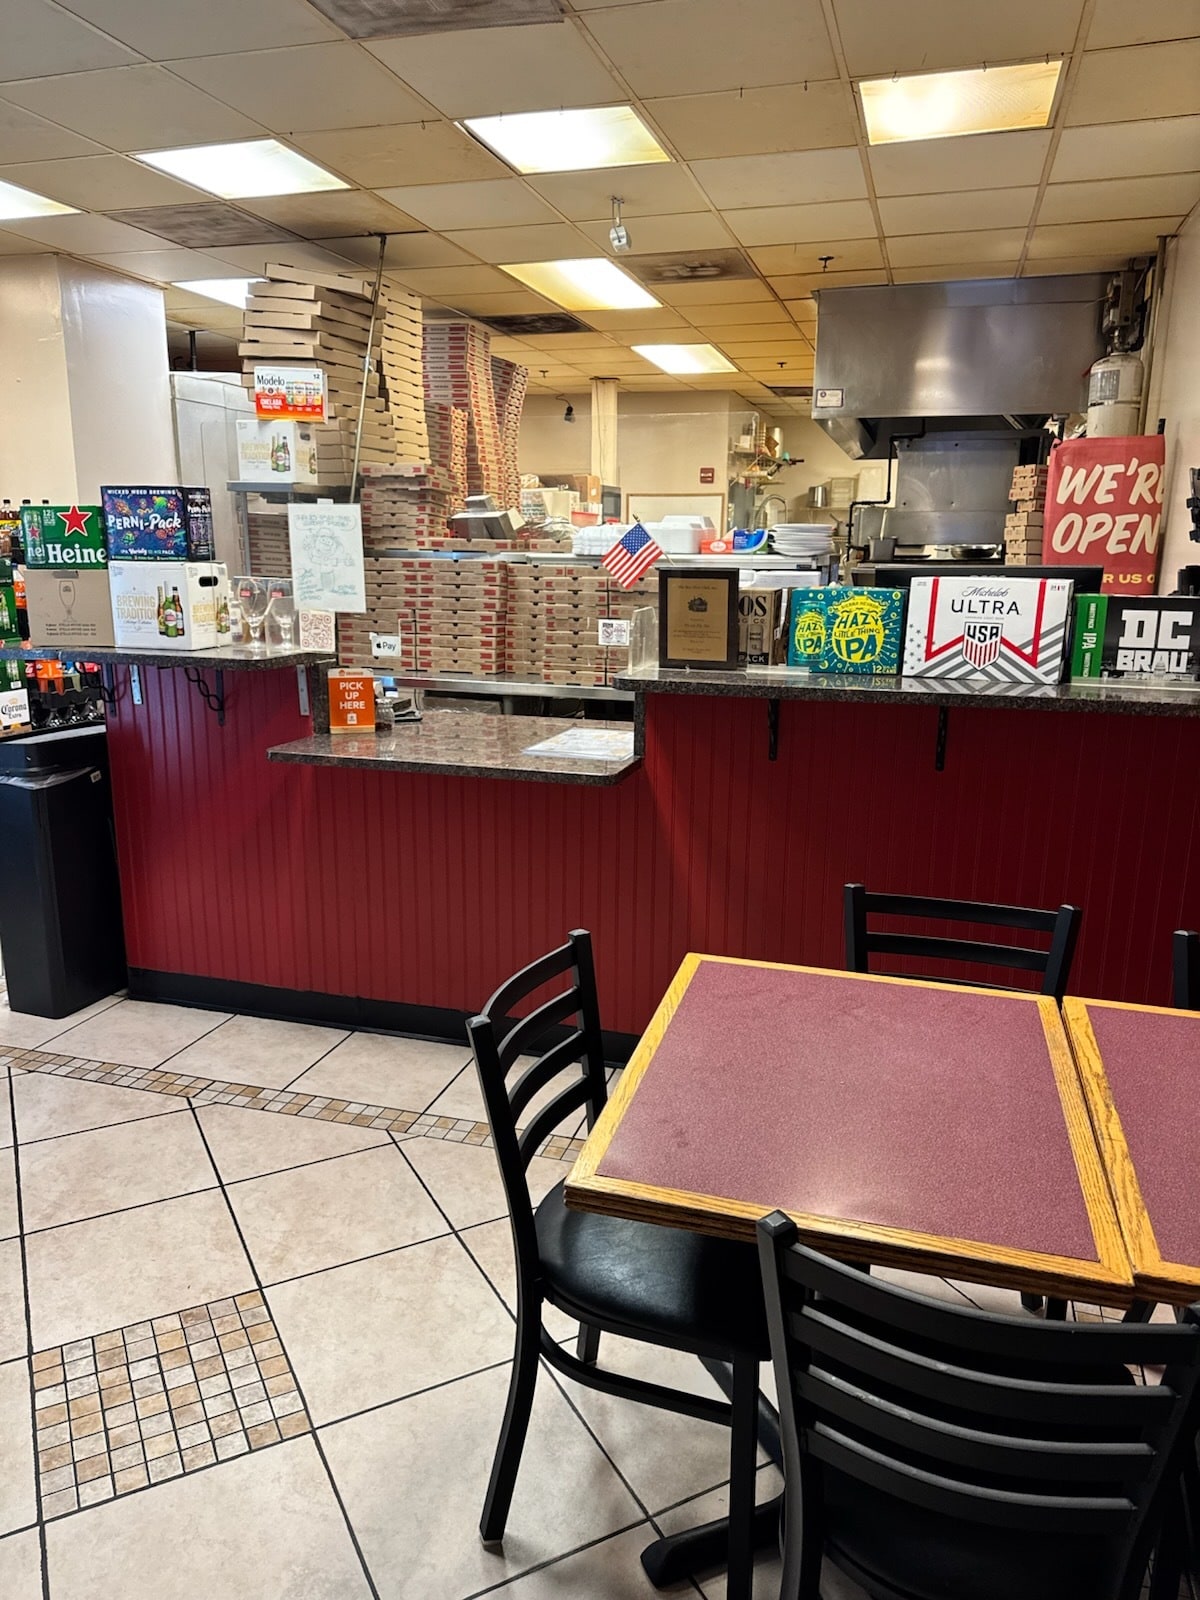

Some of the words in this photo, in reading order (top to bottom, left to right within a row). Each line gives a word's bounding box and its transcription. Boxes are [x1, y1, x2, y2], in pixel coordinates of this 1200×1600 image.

[257, 374, 285, 386] Modelo
[1052, 512, 1161, 555] OPEN
[46, 543, 107, 564] Heine
[1118, 573, 1142, 584] US
[961, 586, 1010, 598] Michelob
[116, 594, 156, 607] BREWING
[951, 599, 1020, 616] ULTRA
[837, 612, 879, 629] HAZY
[798, 622, 823, 633] HAZY
[834, 631, 855, 639] LITTLE
[857, 625, 881, 635] THING
[967, 625, 1000, 643] USA
[1118, 609, 1194, 650] DC
[382, 642, 396, 651] Pay
[797, 636, 822, 652] IPA
[1082, 632, 1097, 650] IPA
[834, 635, 879, 661] IPA
[738, 655, 765, 663] PACK
[1116, 649, 1188, 673] BRAU
[873, 664, 883, 674] 12
[340, 682, 364, 690] PICK
[1, 704, 27, 715] Corona
[340, 701, 366, 709] HERE
